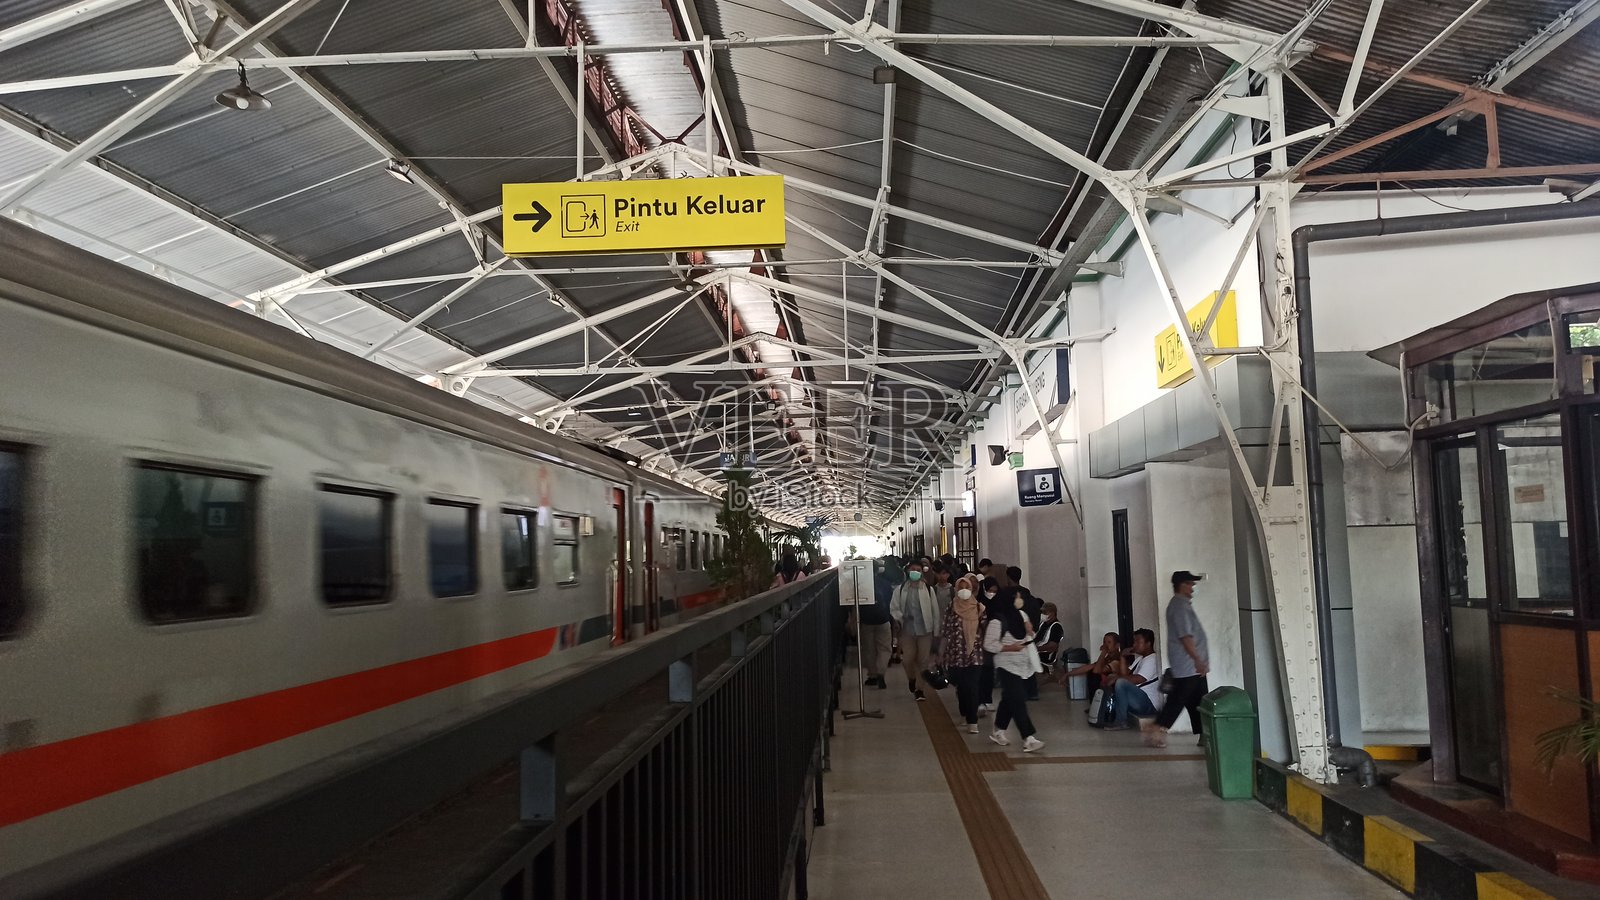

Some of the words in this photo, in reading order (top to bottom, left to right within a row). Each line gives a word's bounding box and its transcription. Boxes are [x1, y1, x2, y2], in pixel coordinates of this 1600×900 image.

[614, 197, 677, 218] Pintu
[686, 194, 766, 215] Keluar
[615, 220, 640, 232] Exit
